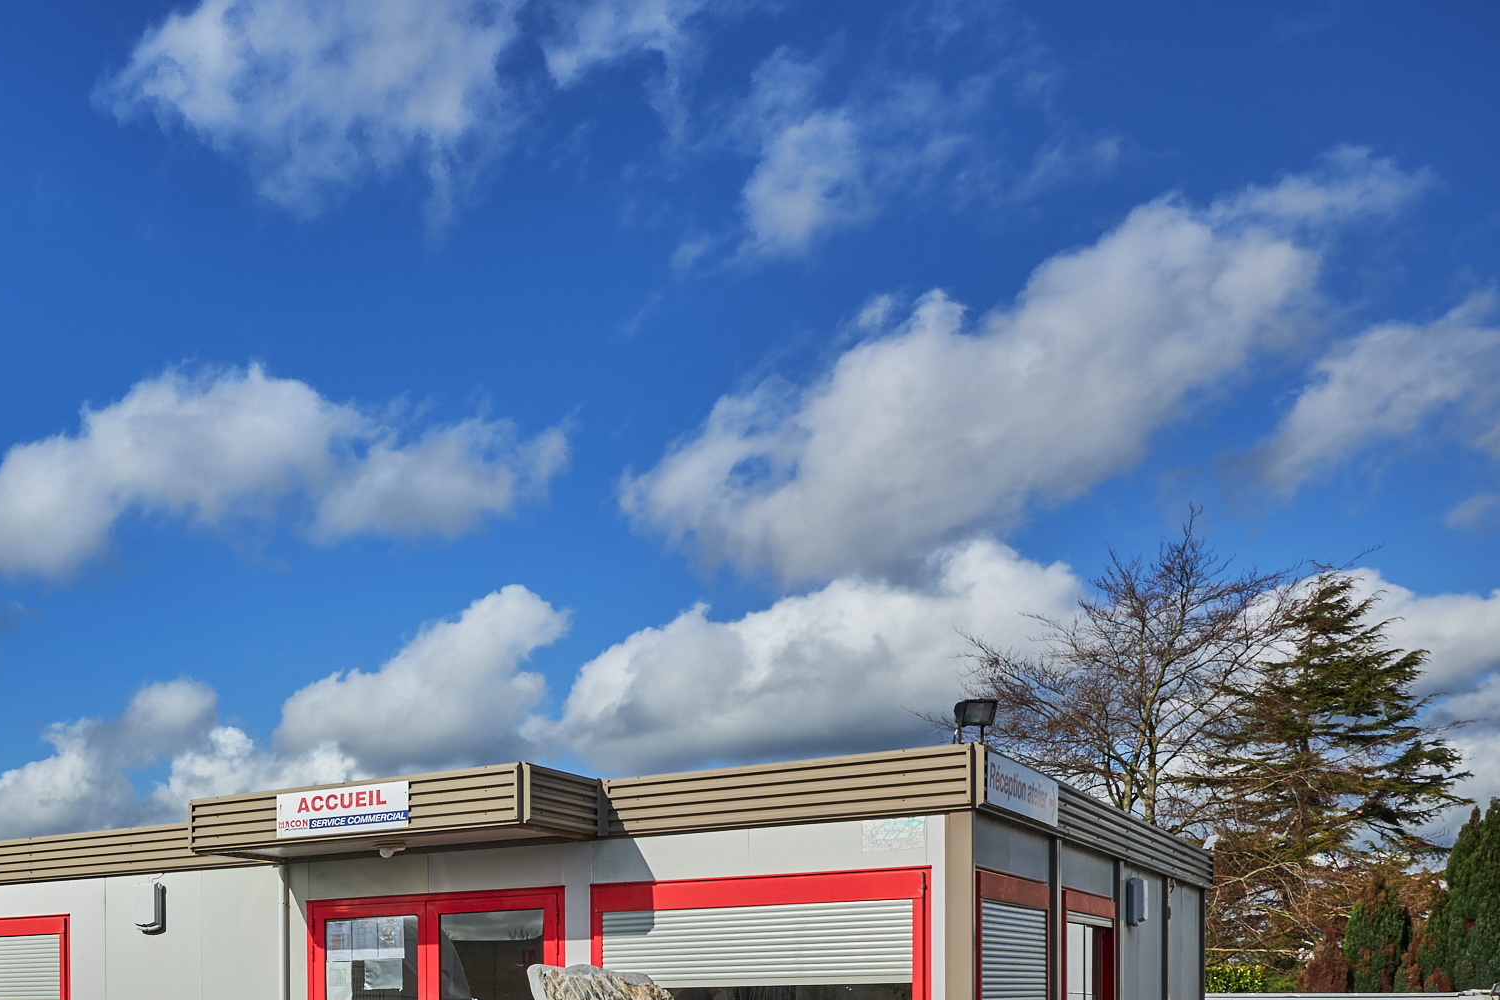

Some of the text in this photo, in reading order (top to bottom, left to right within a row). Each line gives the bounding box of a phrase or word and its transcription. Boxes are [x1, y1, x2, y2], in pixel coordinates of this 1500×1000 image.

[989, 762, 1048, 810] Réception atelier
[297, 789, 387, 813] ACCUEIL
[278, 819, 308, 829] MACON
[311, 812, 406, 828] SERVICE COMMERCIAL
